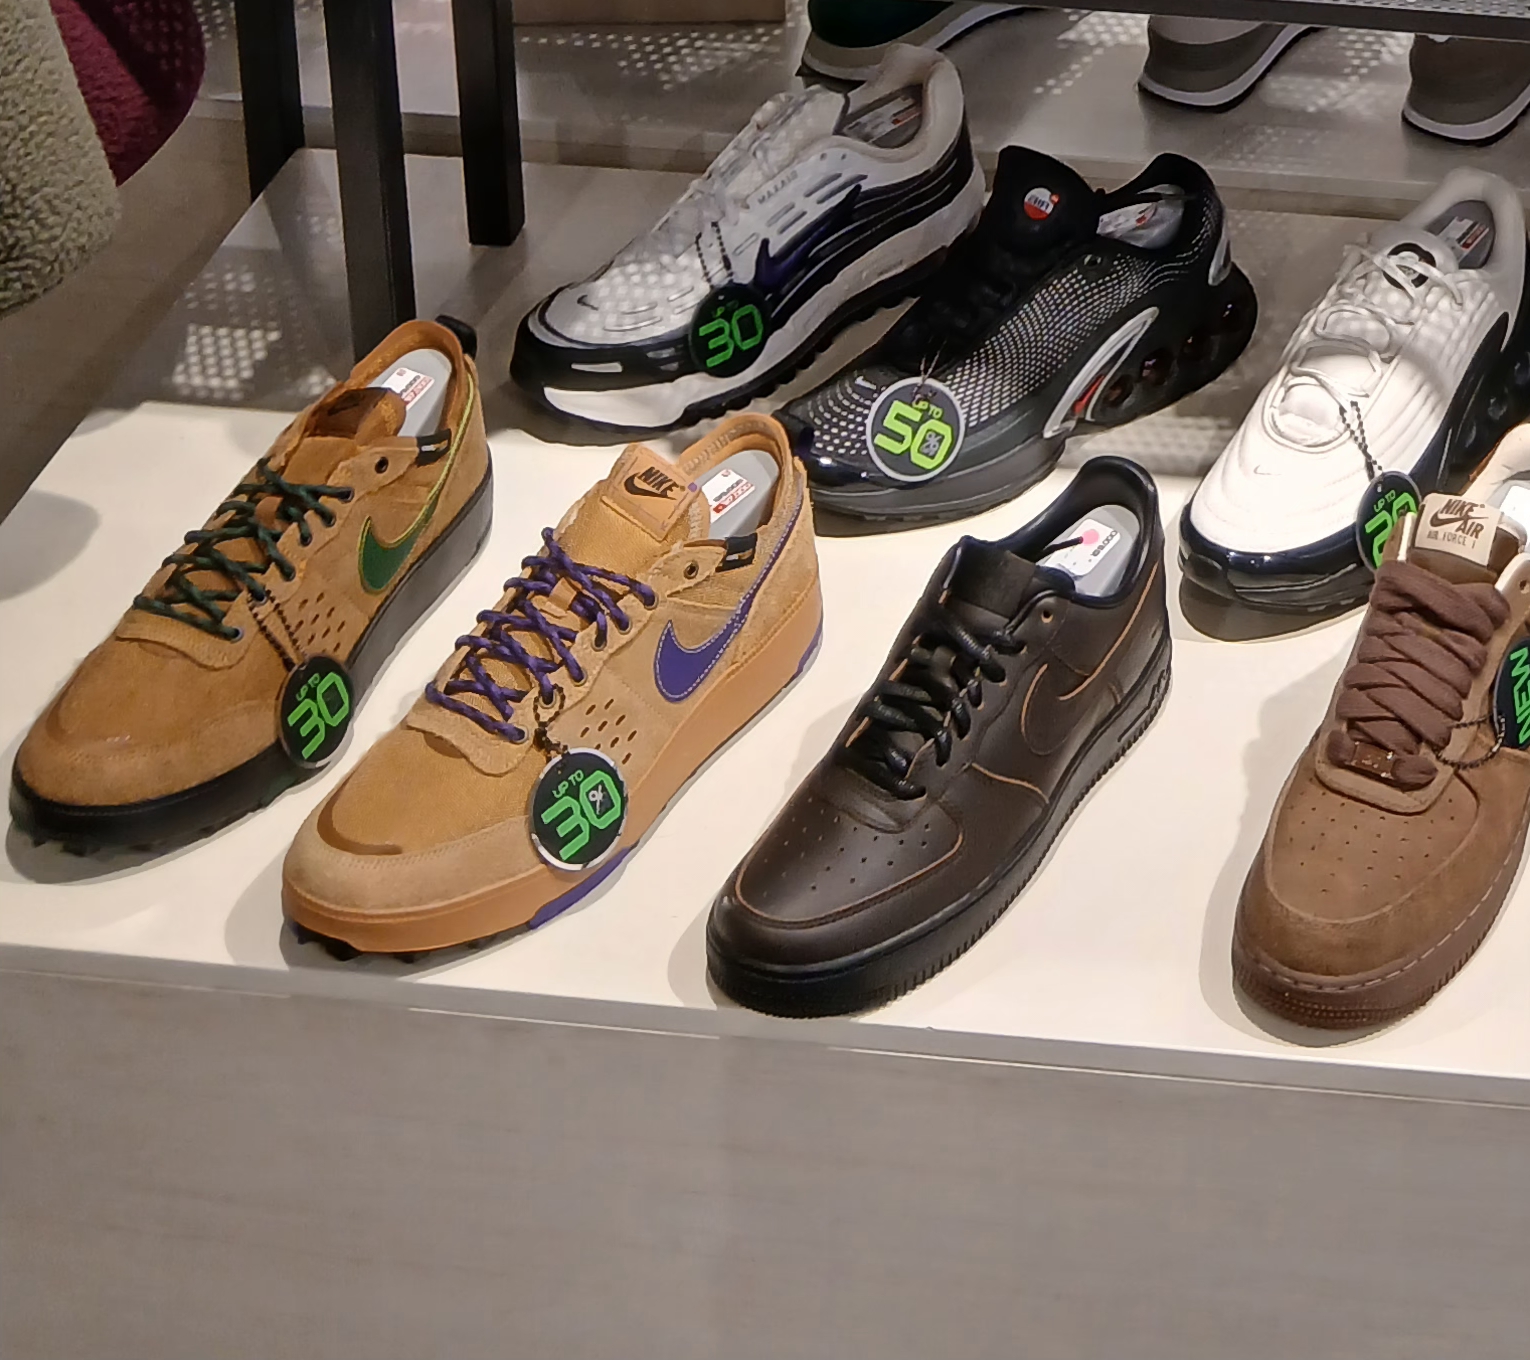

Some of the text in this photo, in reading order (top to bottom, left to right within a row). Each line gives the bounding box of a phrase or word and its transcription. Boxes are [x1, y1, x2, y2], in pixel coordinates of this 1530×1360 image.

[699, 304, 764, 368] 30
[638, 467, 680, 496] NIKE
[1373, 488, 1397, 513] UP TO
[1441, 498, 1478, 518] NIKE
[1456, 522, 1484, 539] AIR
[288, 670, 351, 760] 30
[552, 769, 585, 799] UP TO
